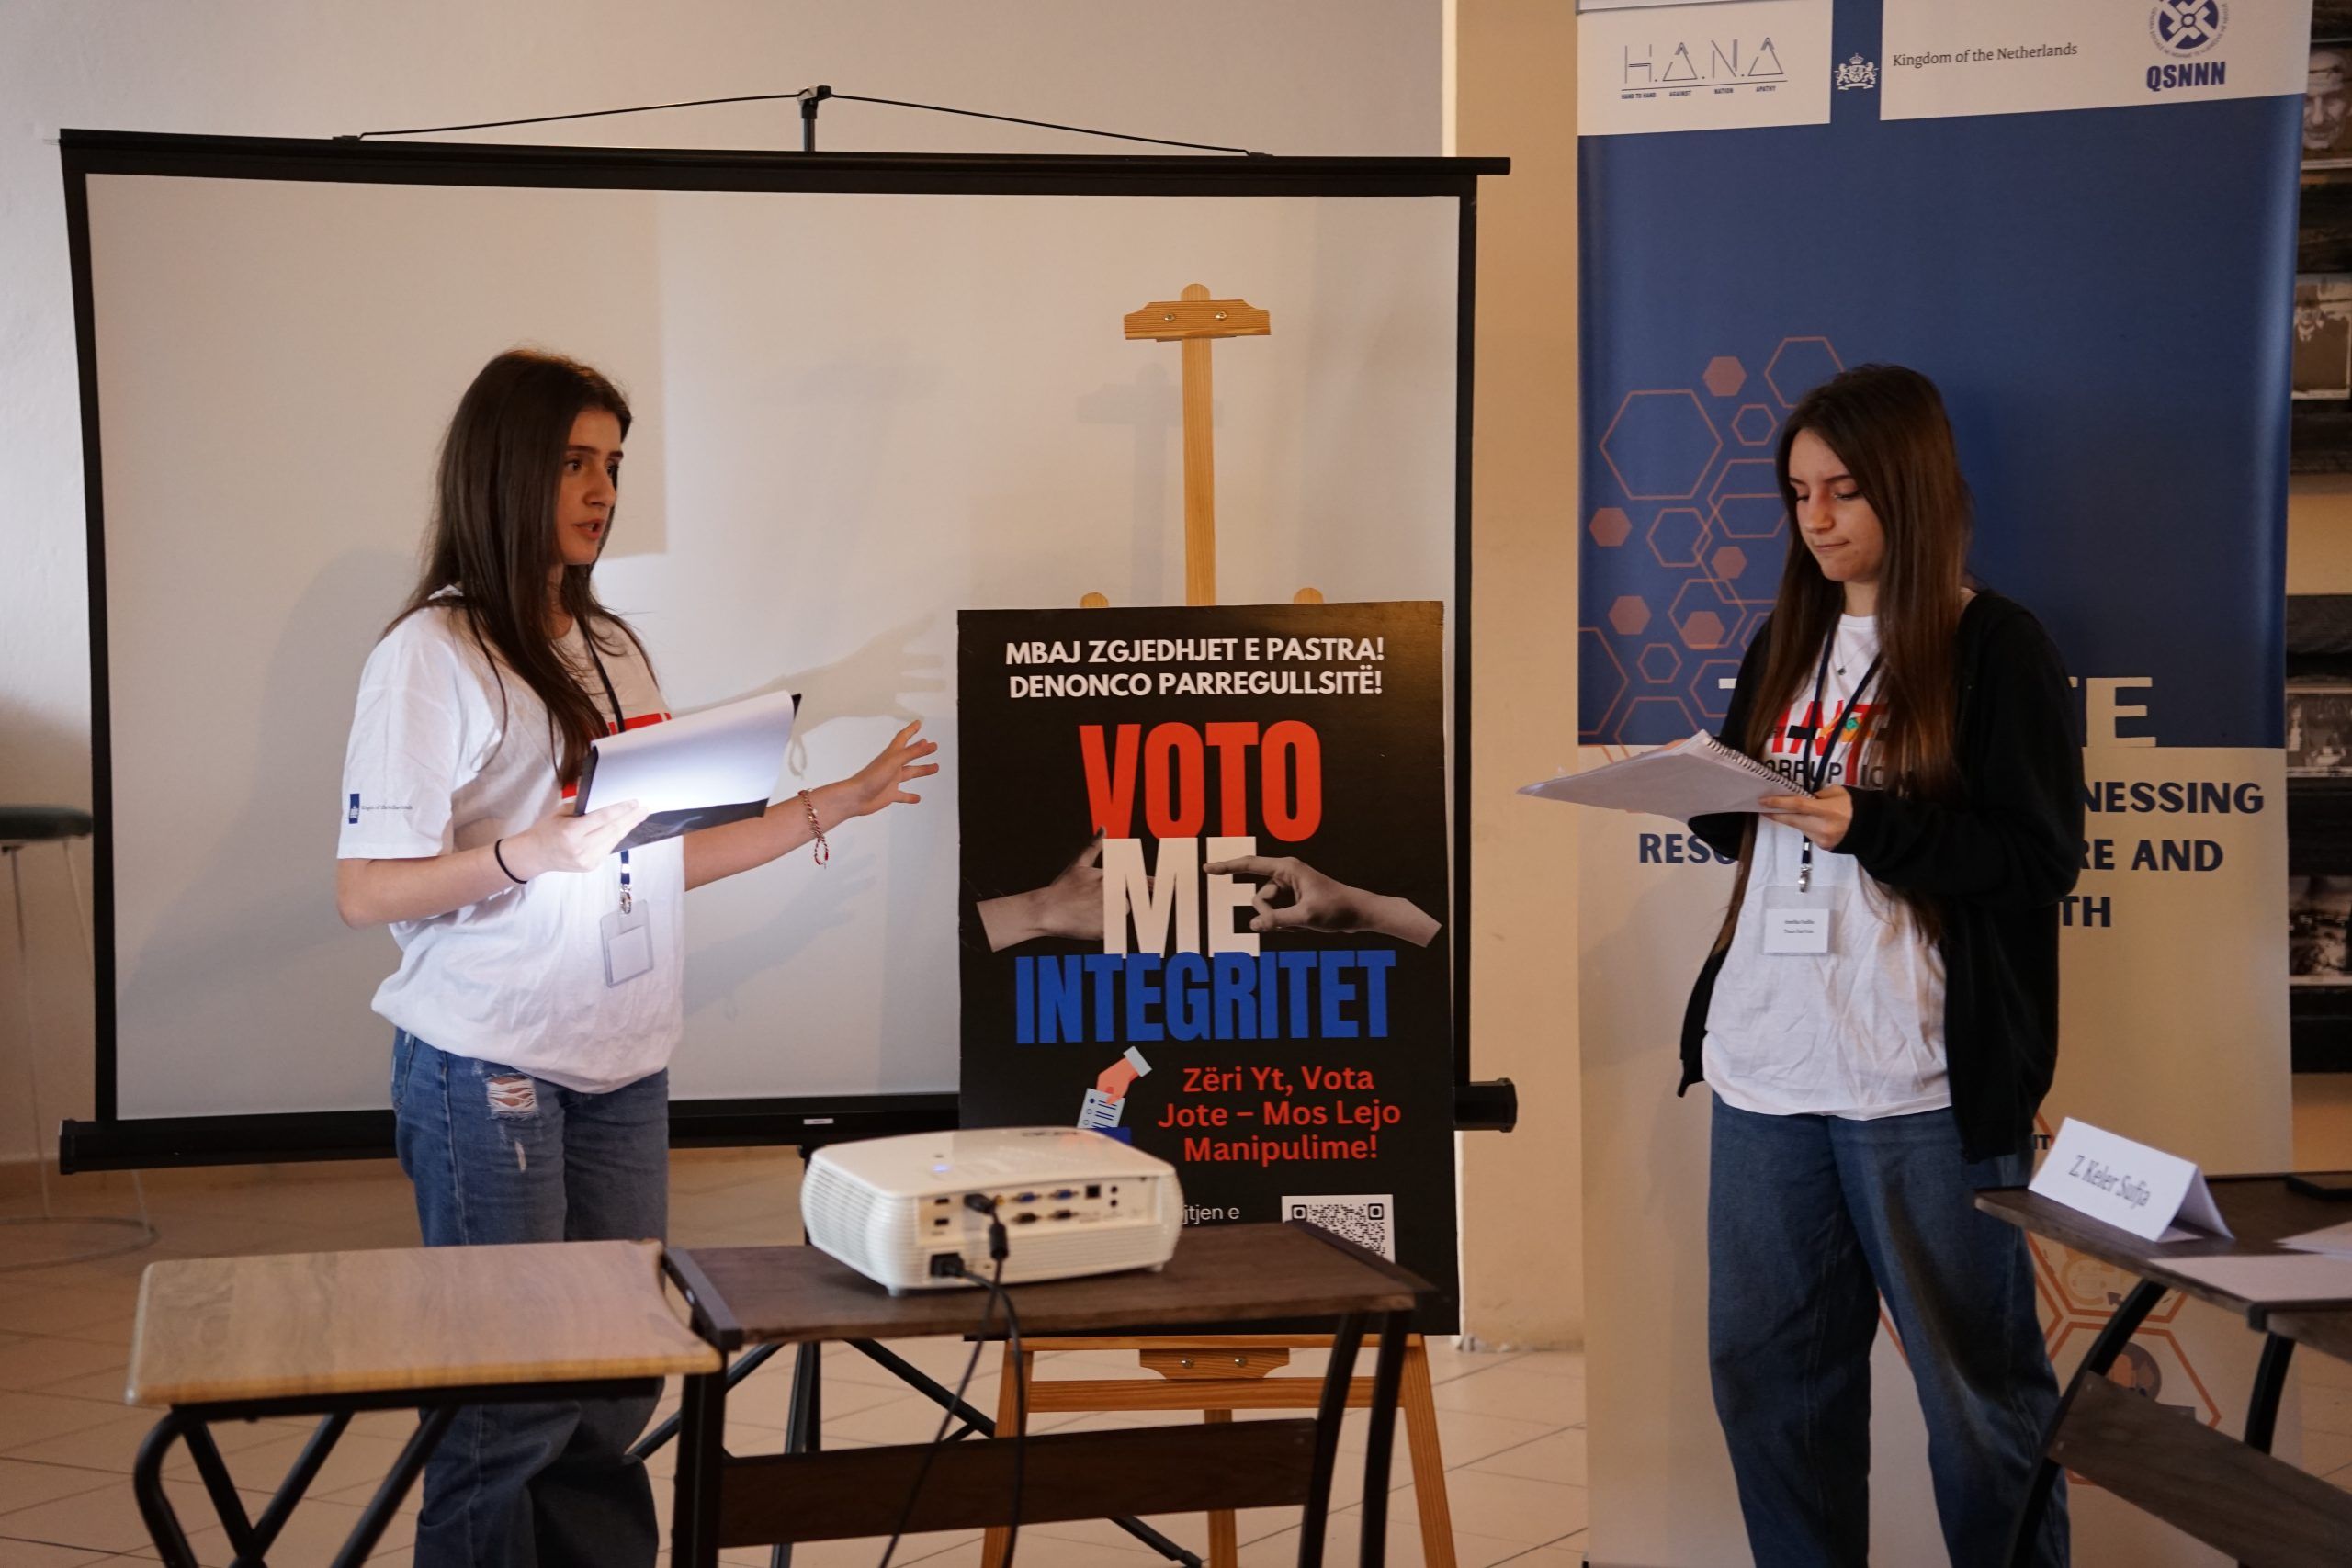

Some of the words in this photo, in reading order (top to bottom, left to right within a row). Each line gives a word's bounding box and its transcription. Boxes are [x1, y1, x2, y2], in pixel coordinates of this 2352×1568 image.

[1893, 51, 1951, 69] Kingdom
[1955, 49, 1970, 62] of
[1973, 48, 1994, 62] the
[1996, 42, 2078, 61] Netherlands
[2146, 61, 2226, 92] QSNNN
[1005, 641, 1080, 665] MBAJ
[1088, 638, 1238, 663] ZGJEDHJET
[1245, 637, 1260, 660] E
[1266, 637, 1385, 660] PASTRA!
[1010, 673, 1152, 698] DENONCO
[1159, 664, 1383, 695] PARREGULLSITË!
[1079, 720, 1322, 842] VOTO
[2132, 840, 2224, 872] AND
[1102, 836, 1260, 959] ME
[1015, 950, 1396, 1044] INTEGRITET
[1182, 1066, 1241, 1092] Zëri
[1250, 1066, 1294, 1096] Yt,
[1301, 1066, 1375, 1091] Vota
[1158, 1103, 1228, 1128] Jote
[1263, 1101, 1328, 1126] Mos
[1337, 1100, 1401, 1131] Lejo
[1184, 1134, 1378, 1167] Manipulime!
[1228, 1206, 1240, 1220] e
